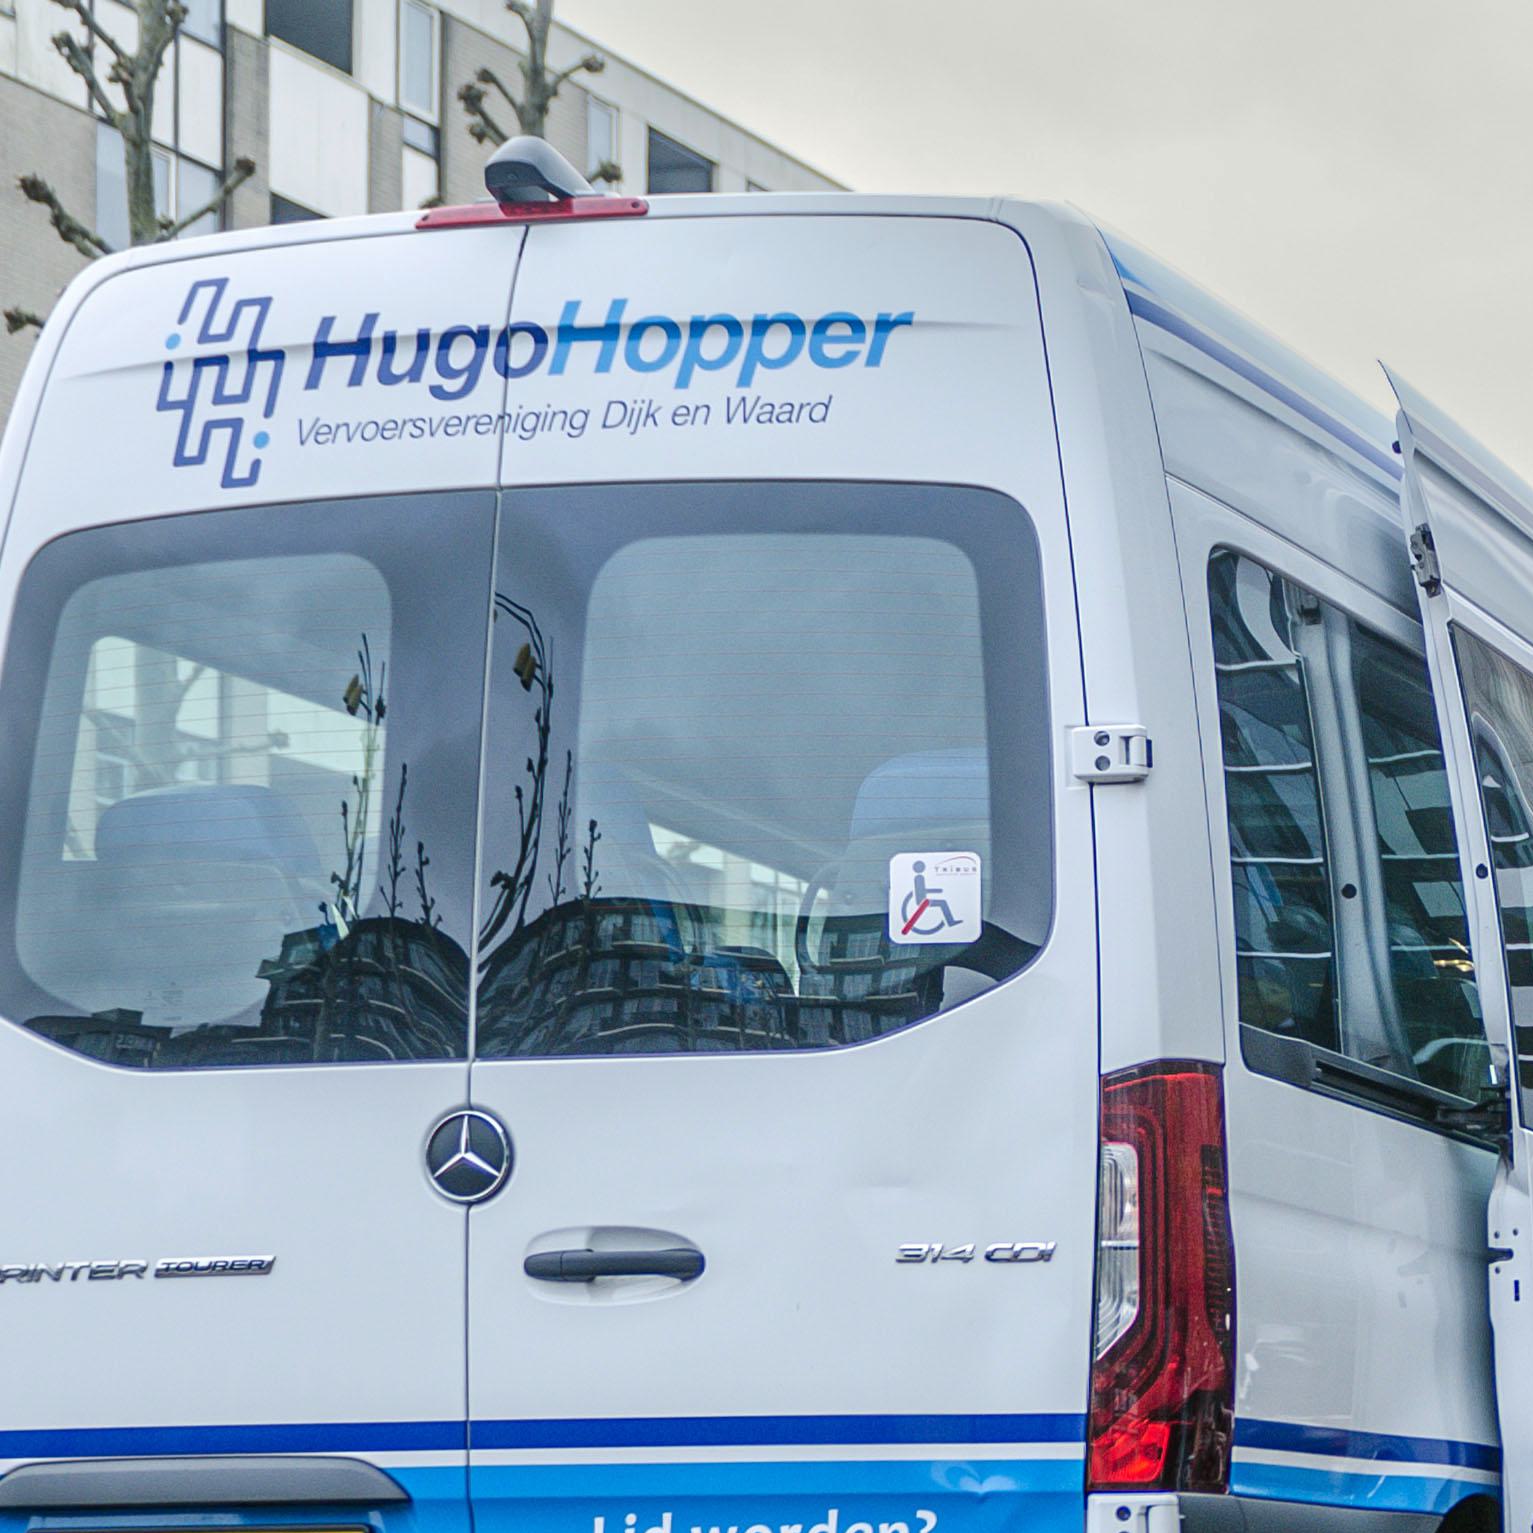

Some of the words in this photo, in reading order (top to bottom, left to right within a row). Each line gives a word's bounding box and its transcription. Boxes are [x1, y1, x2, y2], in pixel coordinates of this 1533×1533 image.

[303, 298, 915, 400] HugoHopper
[297, 404, 589, 446] Vervoersvereniging
[601, 398, 660, 434] Dijk
[672, 401, 711, 427] en
[727, 395, 833, 426] Waard
[160, 1257, 270, 1275] TOURER
[895, 1242, 976, 1263] 314
[984, 1240, 1057, 1263] CDI
